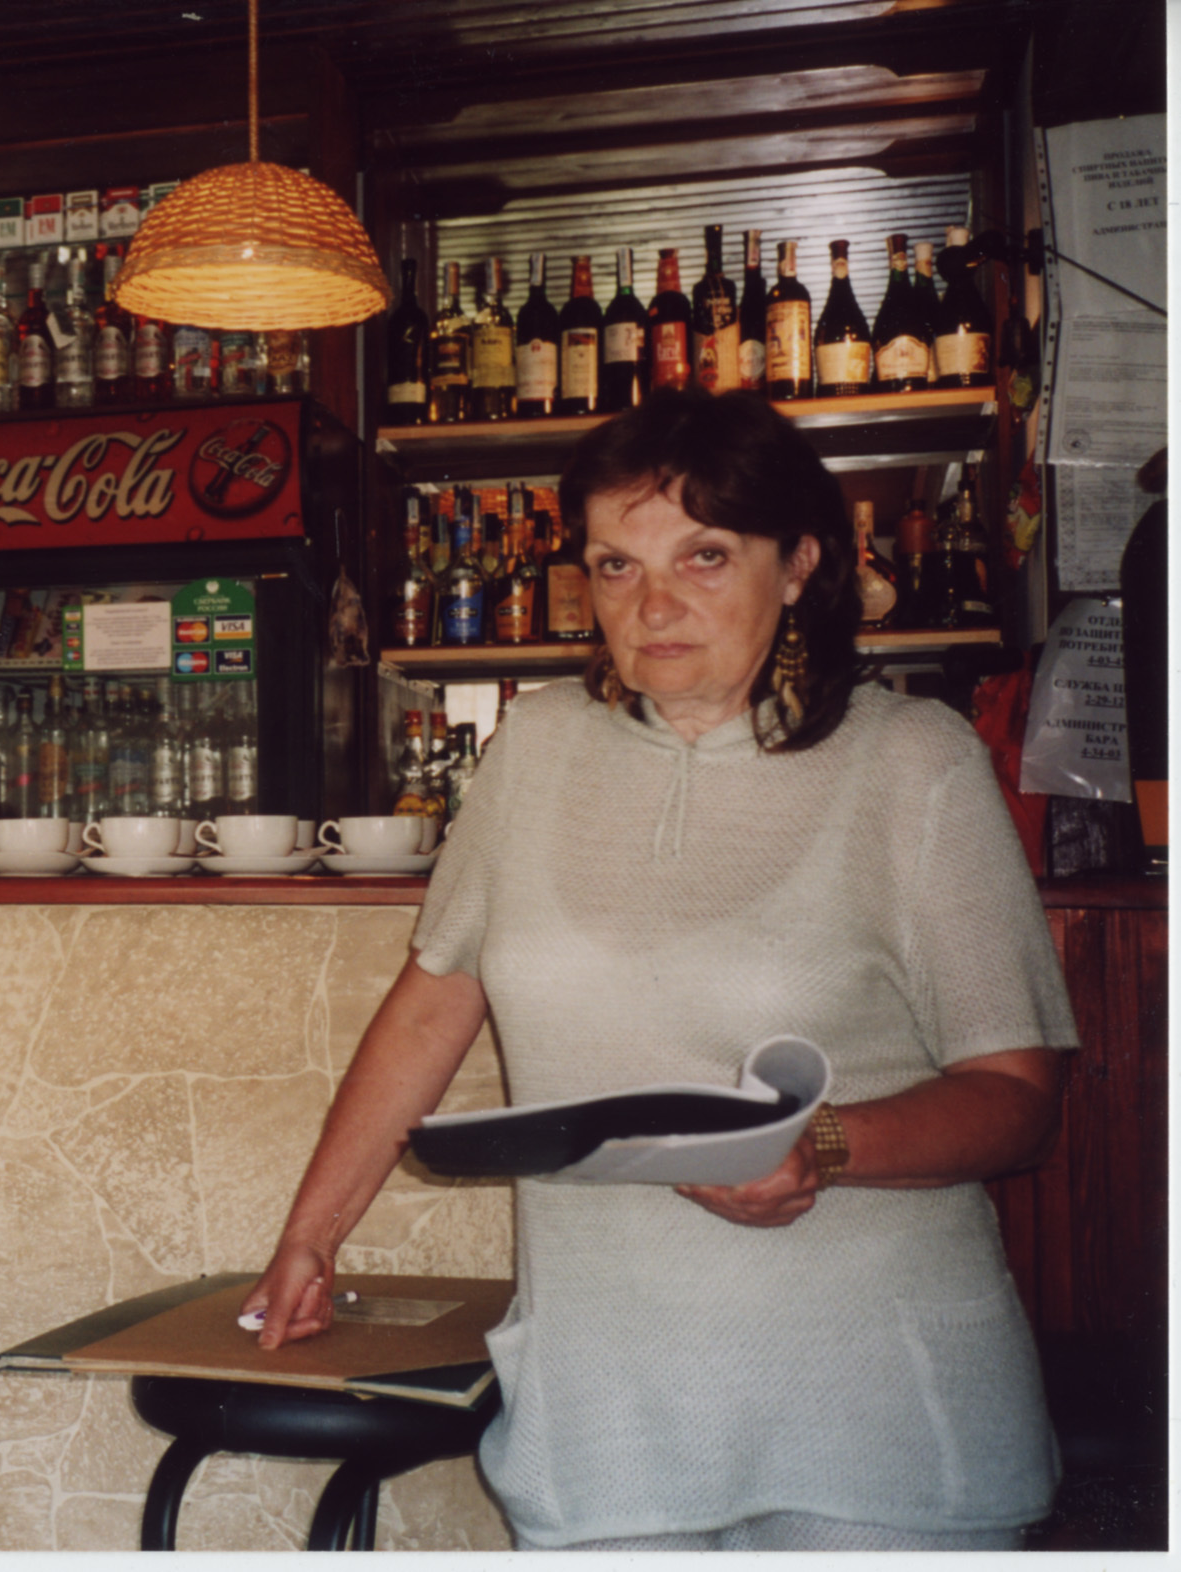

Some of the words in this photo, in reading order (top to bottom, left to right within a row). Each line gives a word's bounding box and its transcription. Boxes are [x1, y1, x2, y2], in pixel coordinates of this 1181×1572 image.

[198, 436, 282, 488] Coca-Cola
[221, 621, 245, 631] VISA
[1054, 679, 1110, 692] СЛУЖБА
[1085, 734, 1118, 745] БАРА
